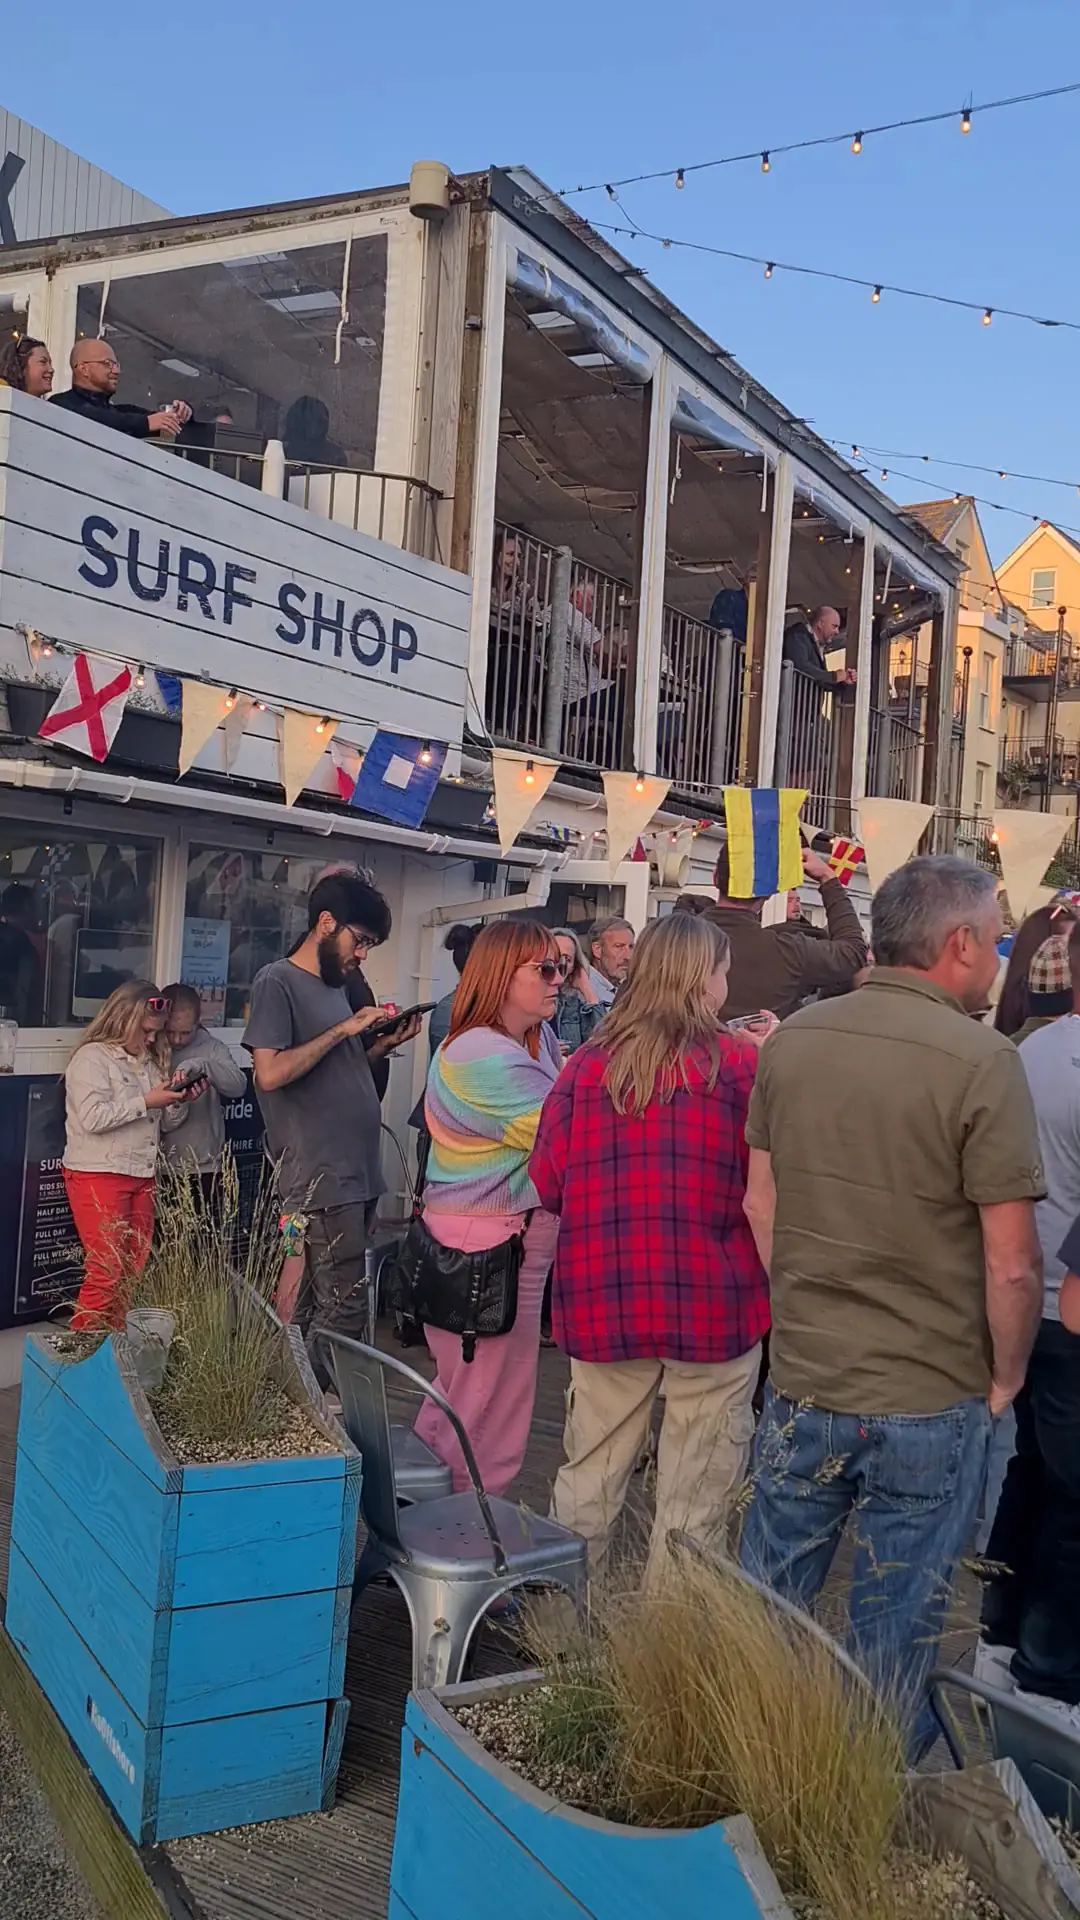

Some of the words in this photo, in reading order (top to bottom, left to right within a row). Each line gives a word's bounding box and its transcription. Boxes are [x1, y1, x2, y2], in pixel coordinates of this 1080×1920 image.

[78, 515, 257, 625] SURF
[275, 583, 418, 674] SHOP
[232, 1139, 253, 1151] HIRE
[40, 1158, 62, 1171] SUR
[39, 1183, 55, 1191] KIDS
[56, 1182, 67, 1190] SU
[37, 1208, 55, 1217] HALF
[56, 1206, 69, 1214] DAY
[35, 1230, 51, 1239] FULL
[53, 1228, 66, 1236] DAY
[33, 1252, 49, 1261] FULL
